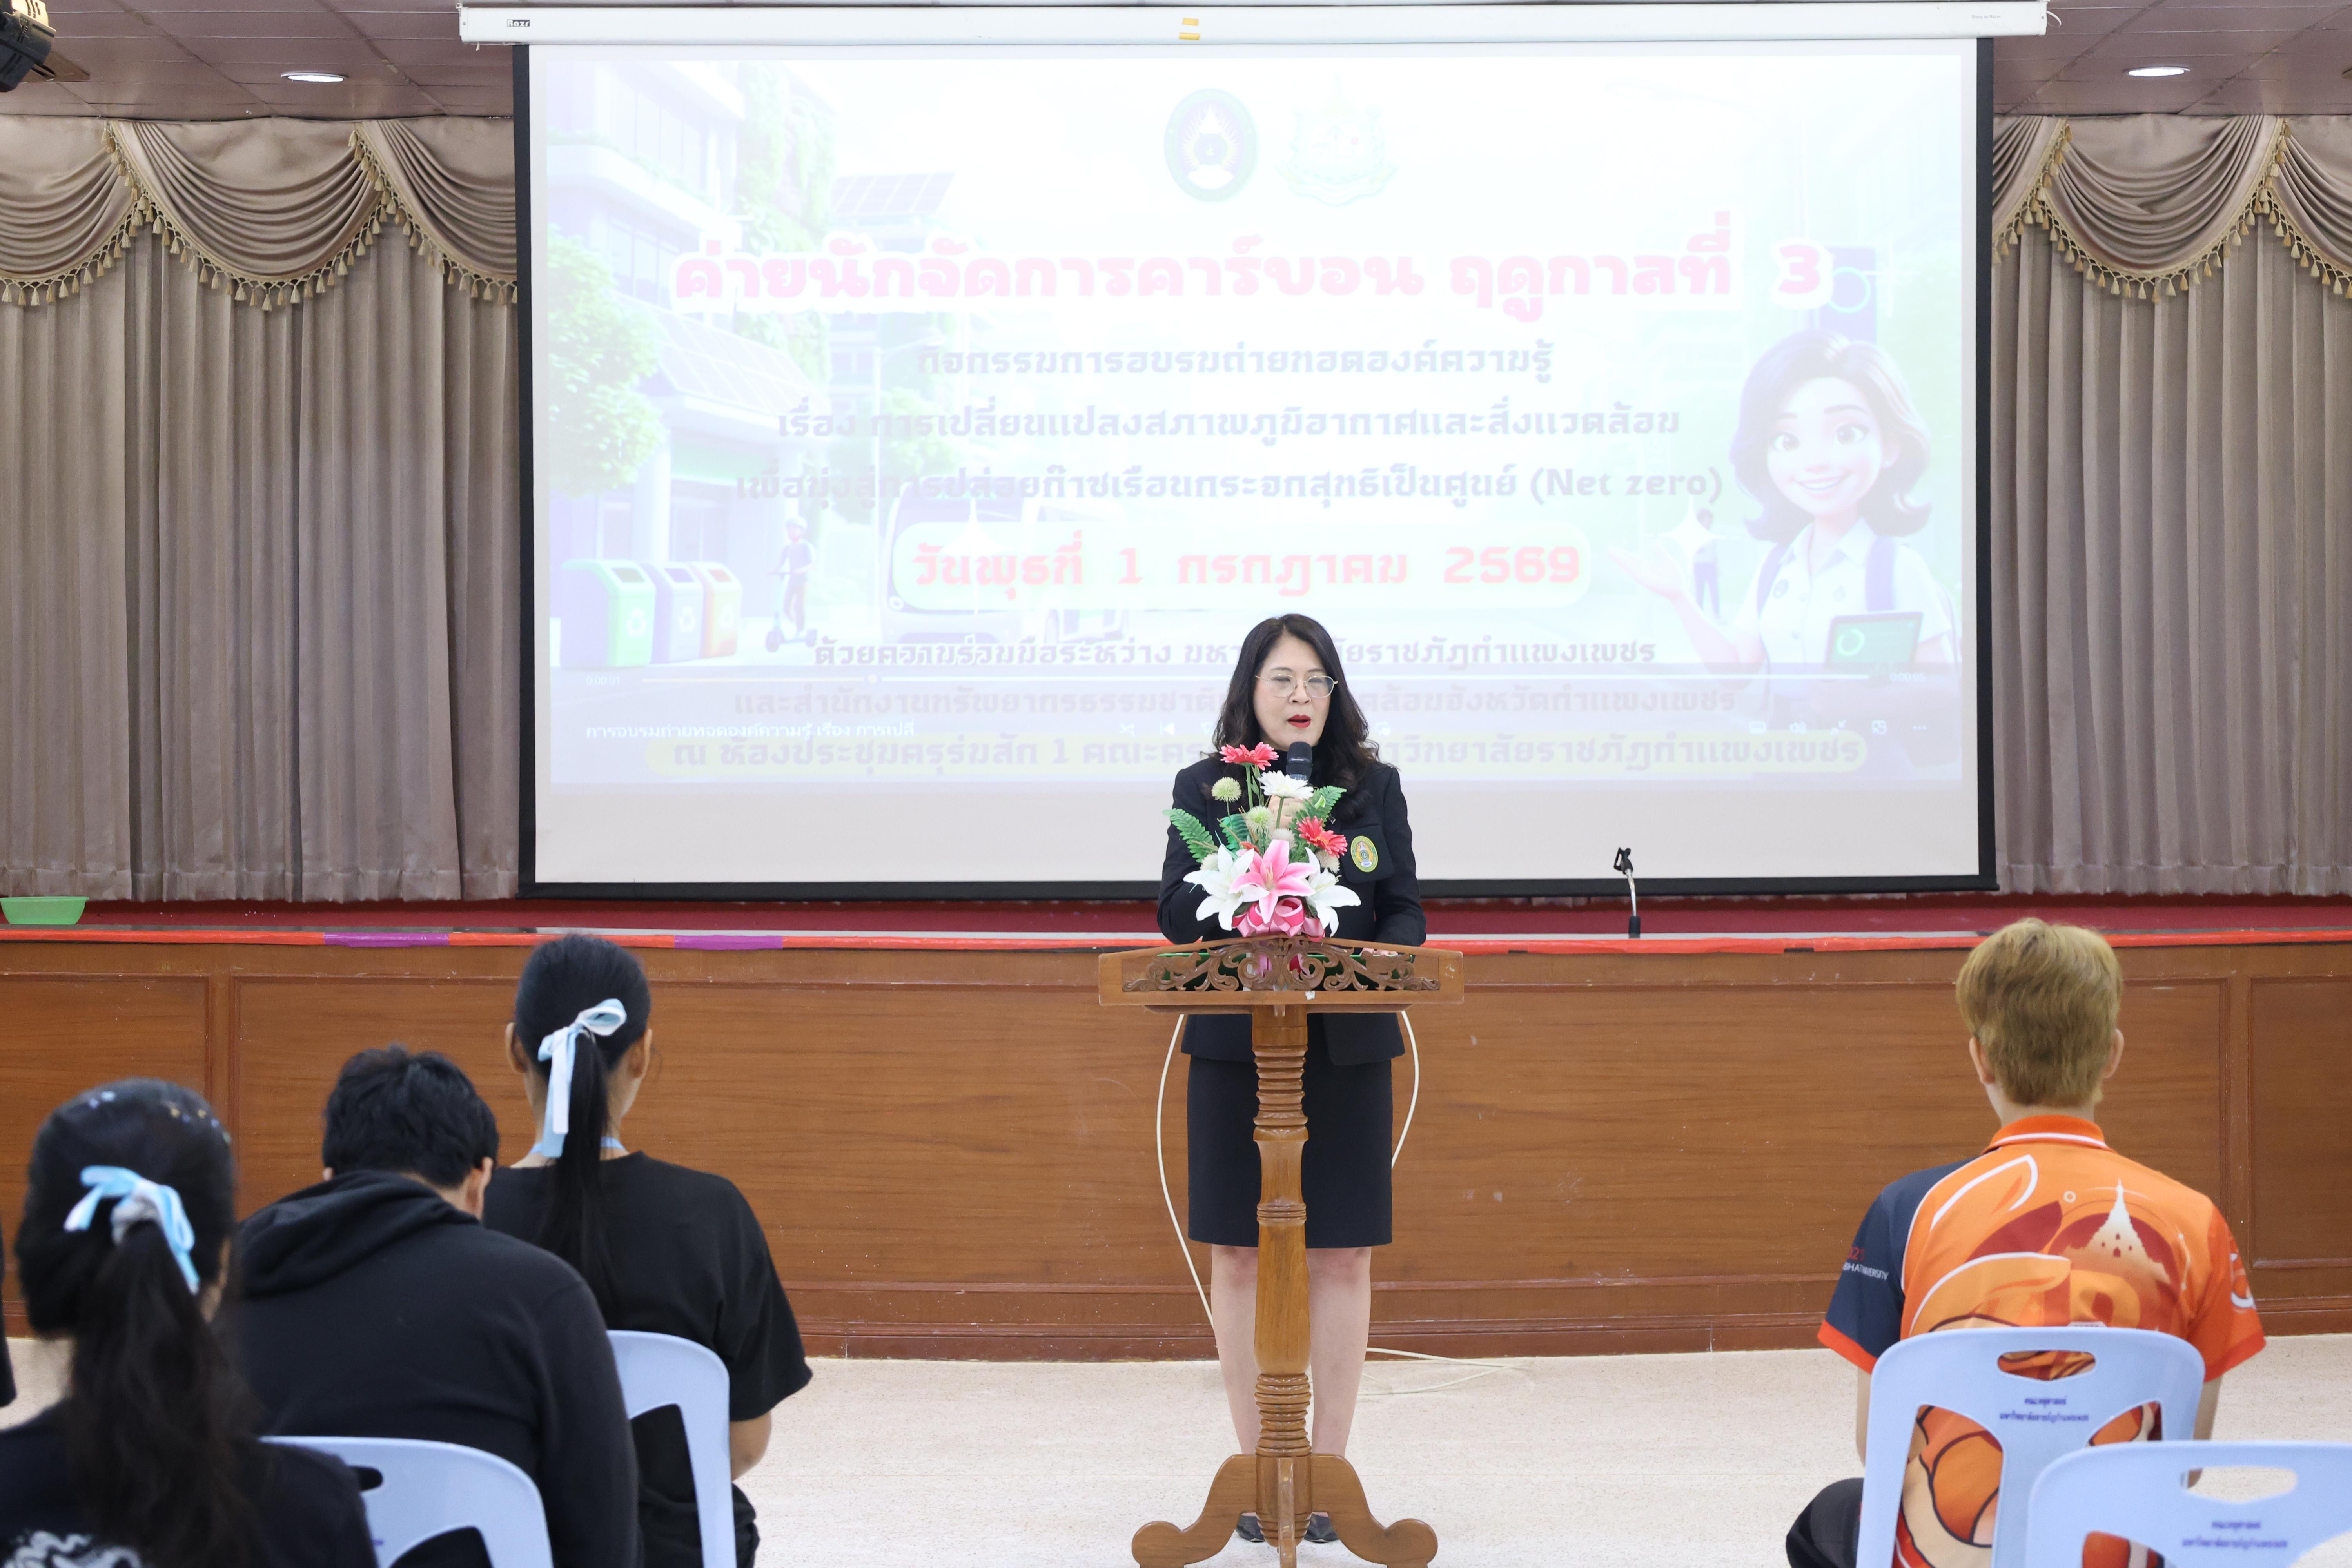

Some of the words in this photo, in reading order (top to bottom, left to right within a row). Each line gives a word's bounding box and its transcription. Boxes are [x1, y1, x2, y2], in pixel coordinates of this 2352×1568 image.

[676, 234, 1425, 297] ค่ายนักจัดการคาร์บอน
[1449, 211, 1730, 322] ฤดูกาลที่
[1779, 245, 1820, 294] 3
[917, 339, 1553, 384] กิจกรรมการอบรมถ่ายทอดองค์ความรู้
[778, 397, 855, 437] เรื่อง
[871, 396, 1679, 446] การเปลี่ยนแปลงสภาพภูมิอากาศและสิ่งแวดล้อม
[736, 459, 1517, 509] เพื่อมุ่งสู่การปล่อยก๊าซเรือนกระจกสุทธิเป็นศูนย์
[1530, 467, 1611, 505] (Net
[1625, 466, 1723, 505] zero)
[912, 529, 1084, 601] วันพุธที่
[1118, 548, 1144, 584] 1
[1177, 554, 1408, 597] กรกฎาคม
[1443, 546, 1580, 584] 2569
[814, 637, 1172, 664] ด้วยความร่วมมือระหว่าง
[586, 721, 813, 741] การอบรมถ่ายทอดองค์ความรู้
[817, 720, 850, 737] เรื่อง
[673, 742, 707, 766] ณ
[1052, 738, 1069, 764] 1
